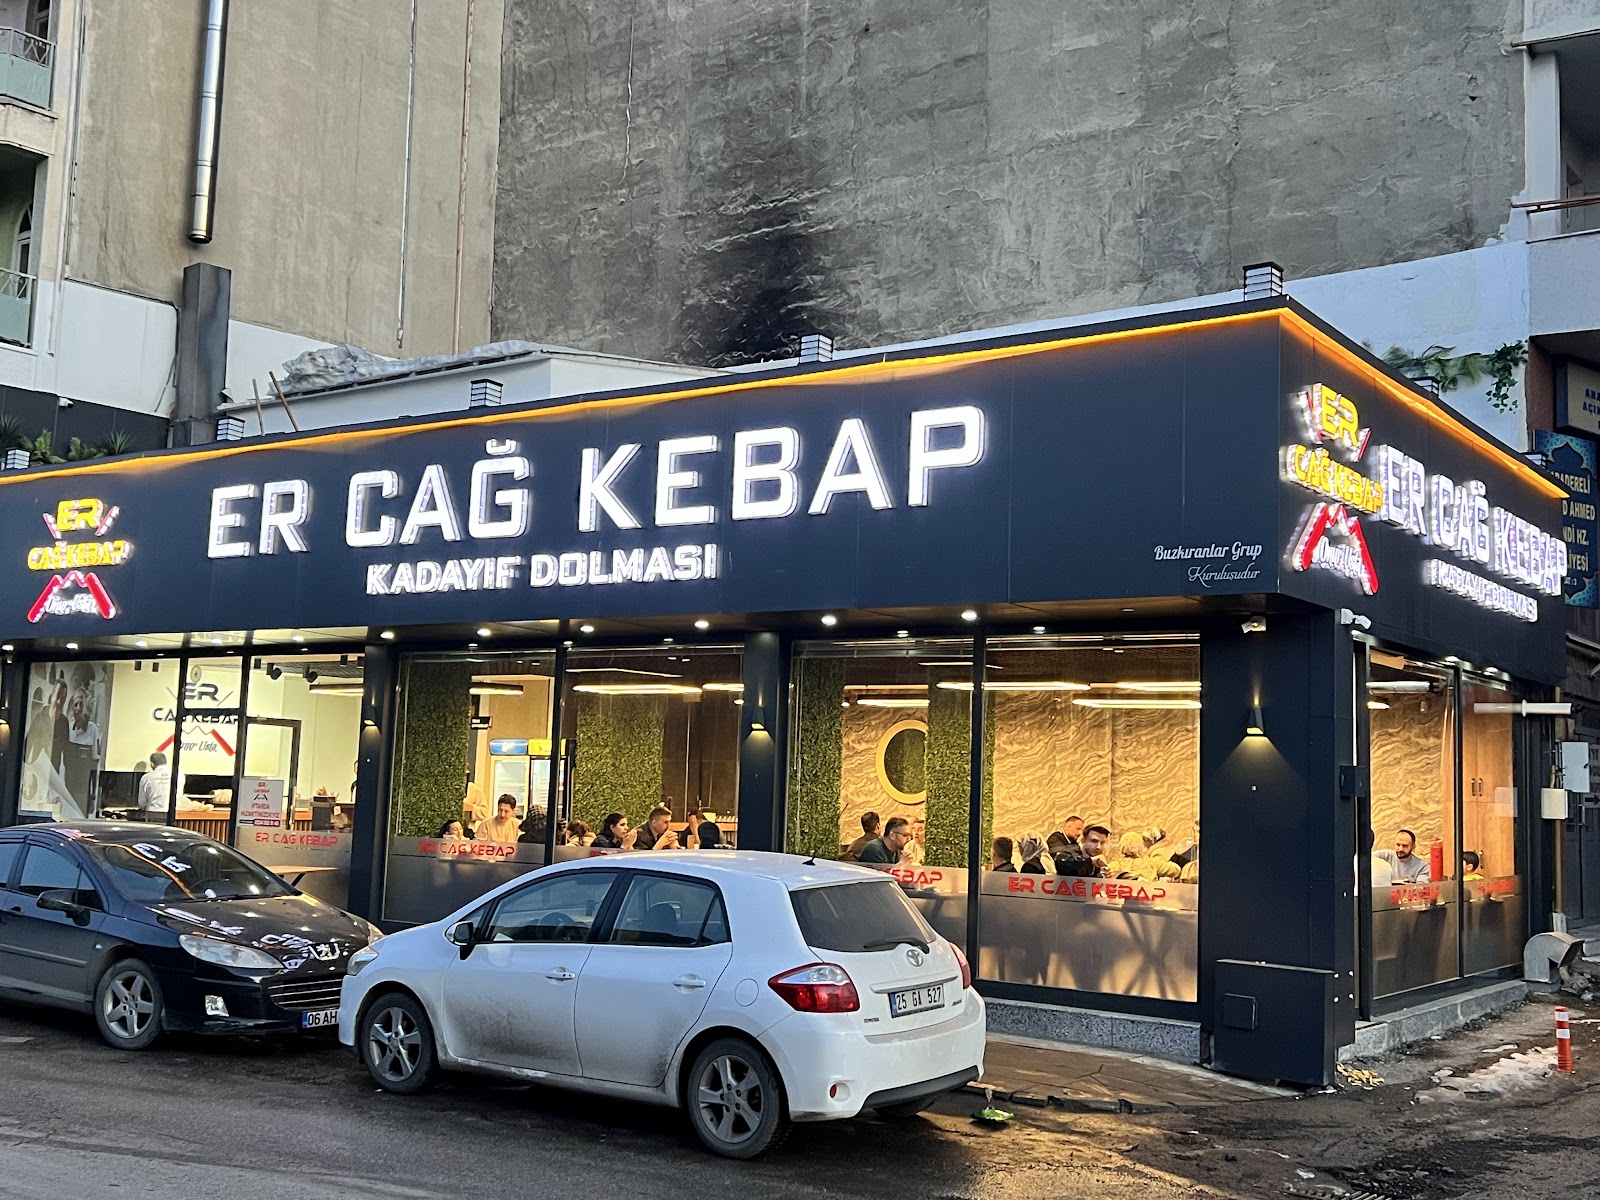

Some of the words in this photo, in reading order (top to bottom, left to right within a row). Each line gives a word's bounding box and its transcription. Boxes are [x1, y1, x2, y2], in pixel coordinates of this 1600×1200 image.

[1312, 383, 1358, 446] ER
[208, 479, 311, 559] ER
[345, 438, 532, 549] CAĞ
[578, 405, 986, 533] KEBAP
[57, 498, 104, 532] ER
[1380, 444, 1427, 536] ER
[1431, 474, 1490, 565] CAĞ
[1493, 507, 1568, 597] KEBAP
[1569, 501, 1596, 521] AHMED
[1154, 543, 1229, 560] Buzkıranlar
[1231, 541, 1263, 560] Grup
[366, 555, 522, 596] KADAYIF
[530, 543, 719, 588] DOLMASI
[1187, 562, 1261, 588] Kuruluşudur
[184, 682, 220, 702] ER
[255, 832, 270, 843] ER
[300, 834, 338, 847] KEBAP
[470, 844, 515, 857] KEBAP
[888, 868, 943, 885] EBAP
[1008, 876, 1036, 893] ER
[1091, 881, 1167, 901] KEBAP
[896, 993, 908, 1011] 25
[927, 986, 942, 1004] 527
[307, 1013, 321, 1026] 06
[322, 1010, 338, 1025] AH
